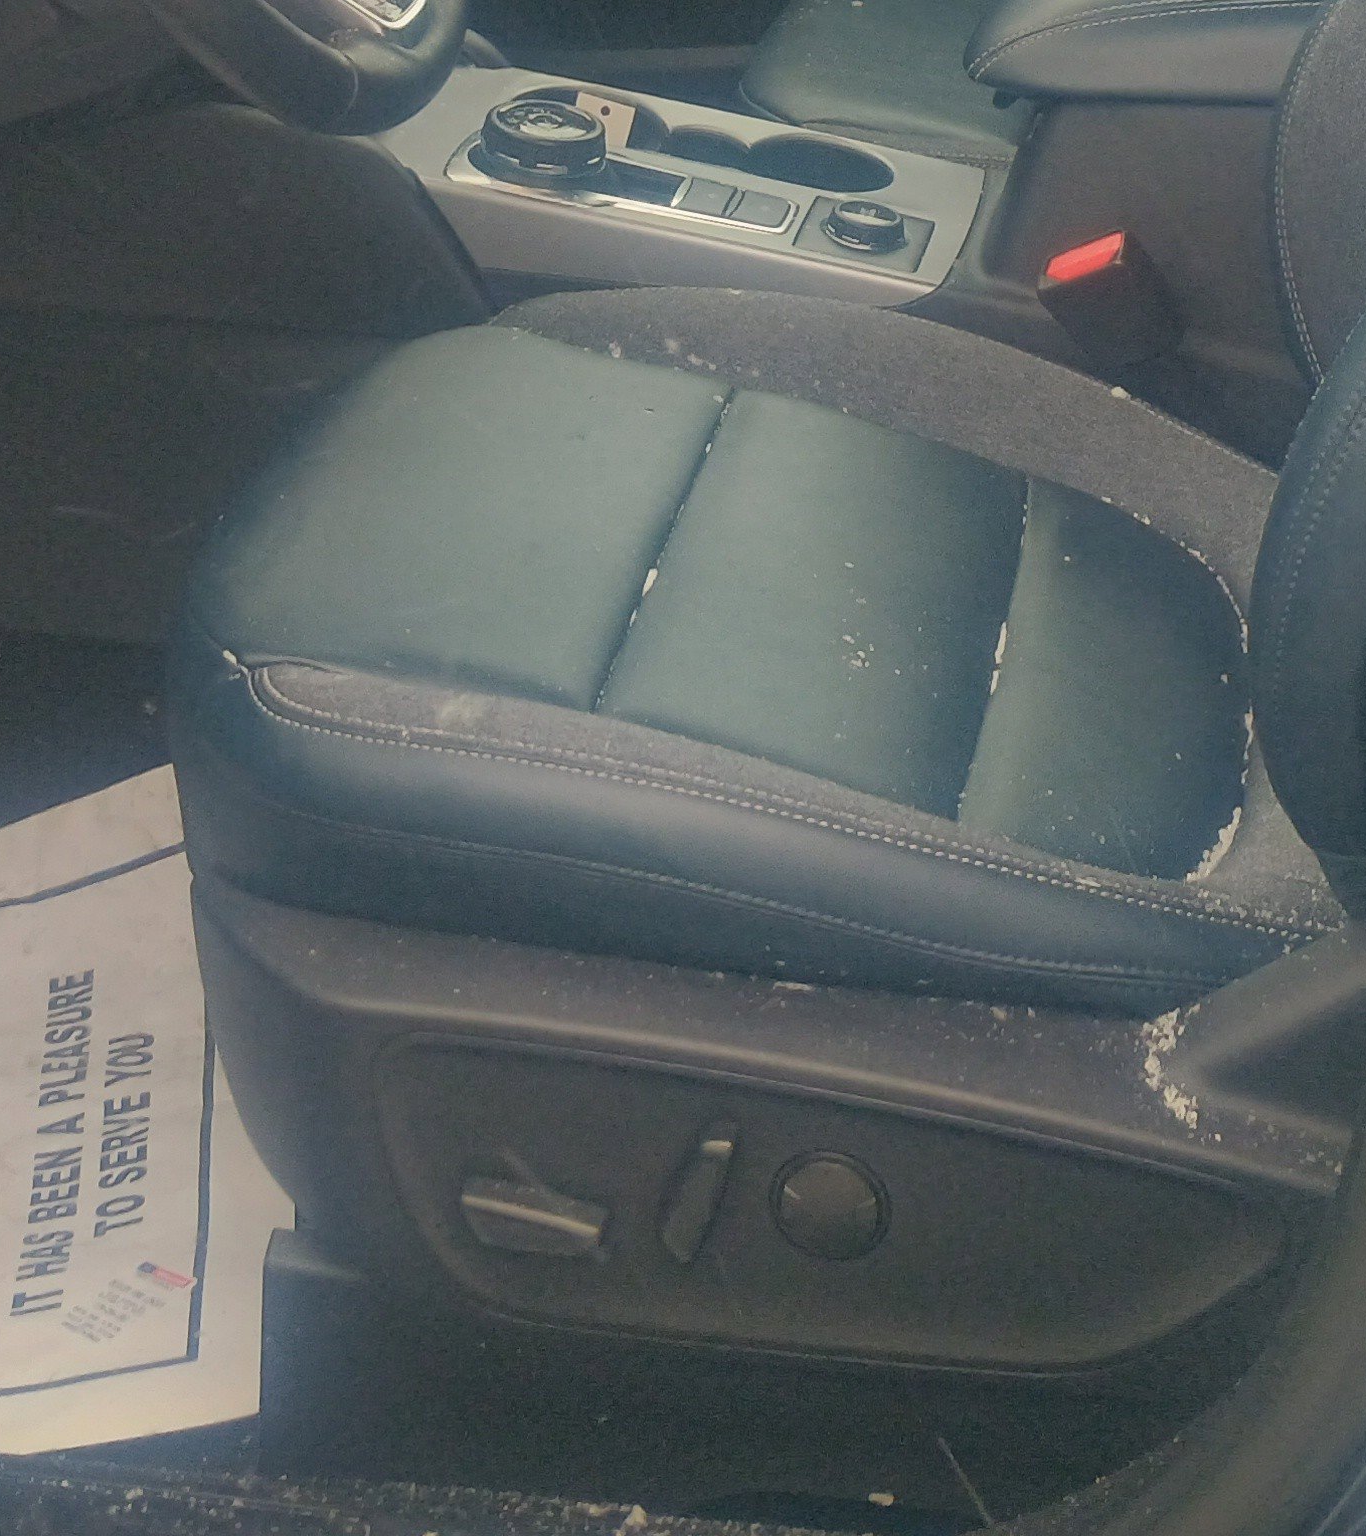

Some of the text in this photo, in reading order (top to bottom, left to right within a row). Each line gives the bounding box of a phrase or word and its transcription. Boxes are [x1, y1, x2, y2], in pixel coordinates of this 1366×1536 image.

[104, 1031, 155, 1088] YOU
[9, 968, 95, 1316] IT HAS BEEN A PLEASURE
[98, 1091, 151, 1189] SERVE
[94, 1194, 146, 1238] TO
